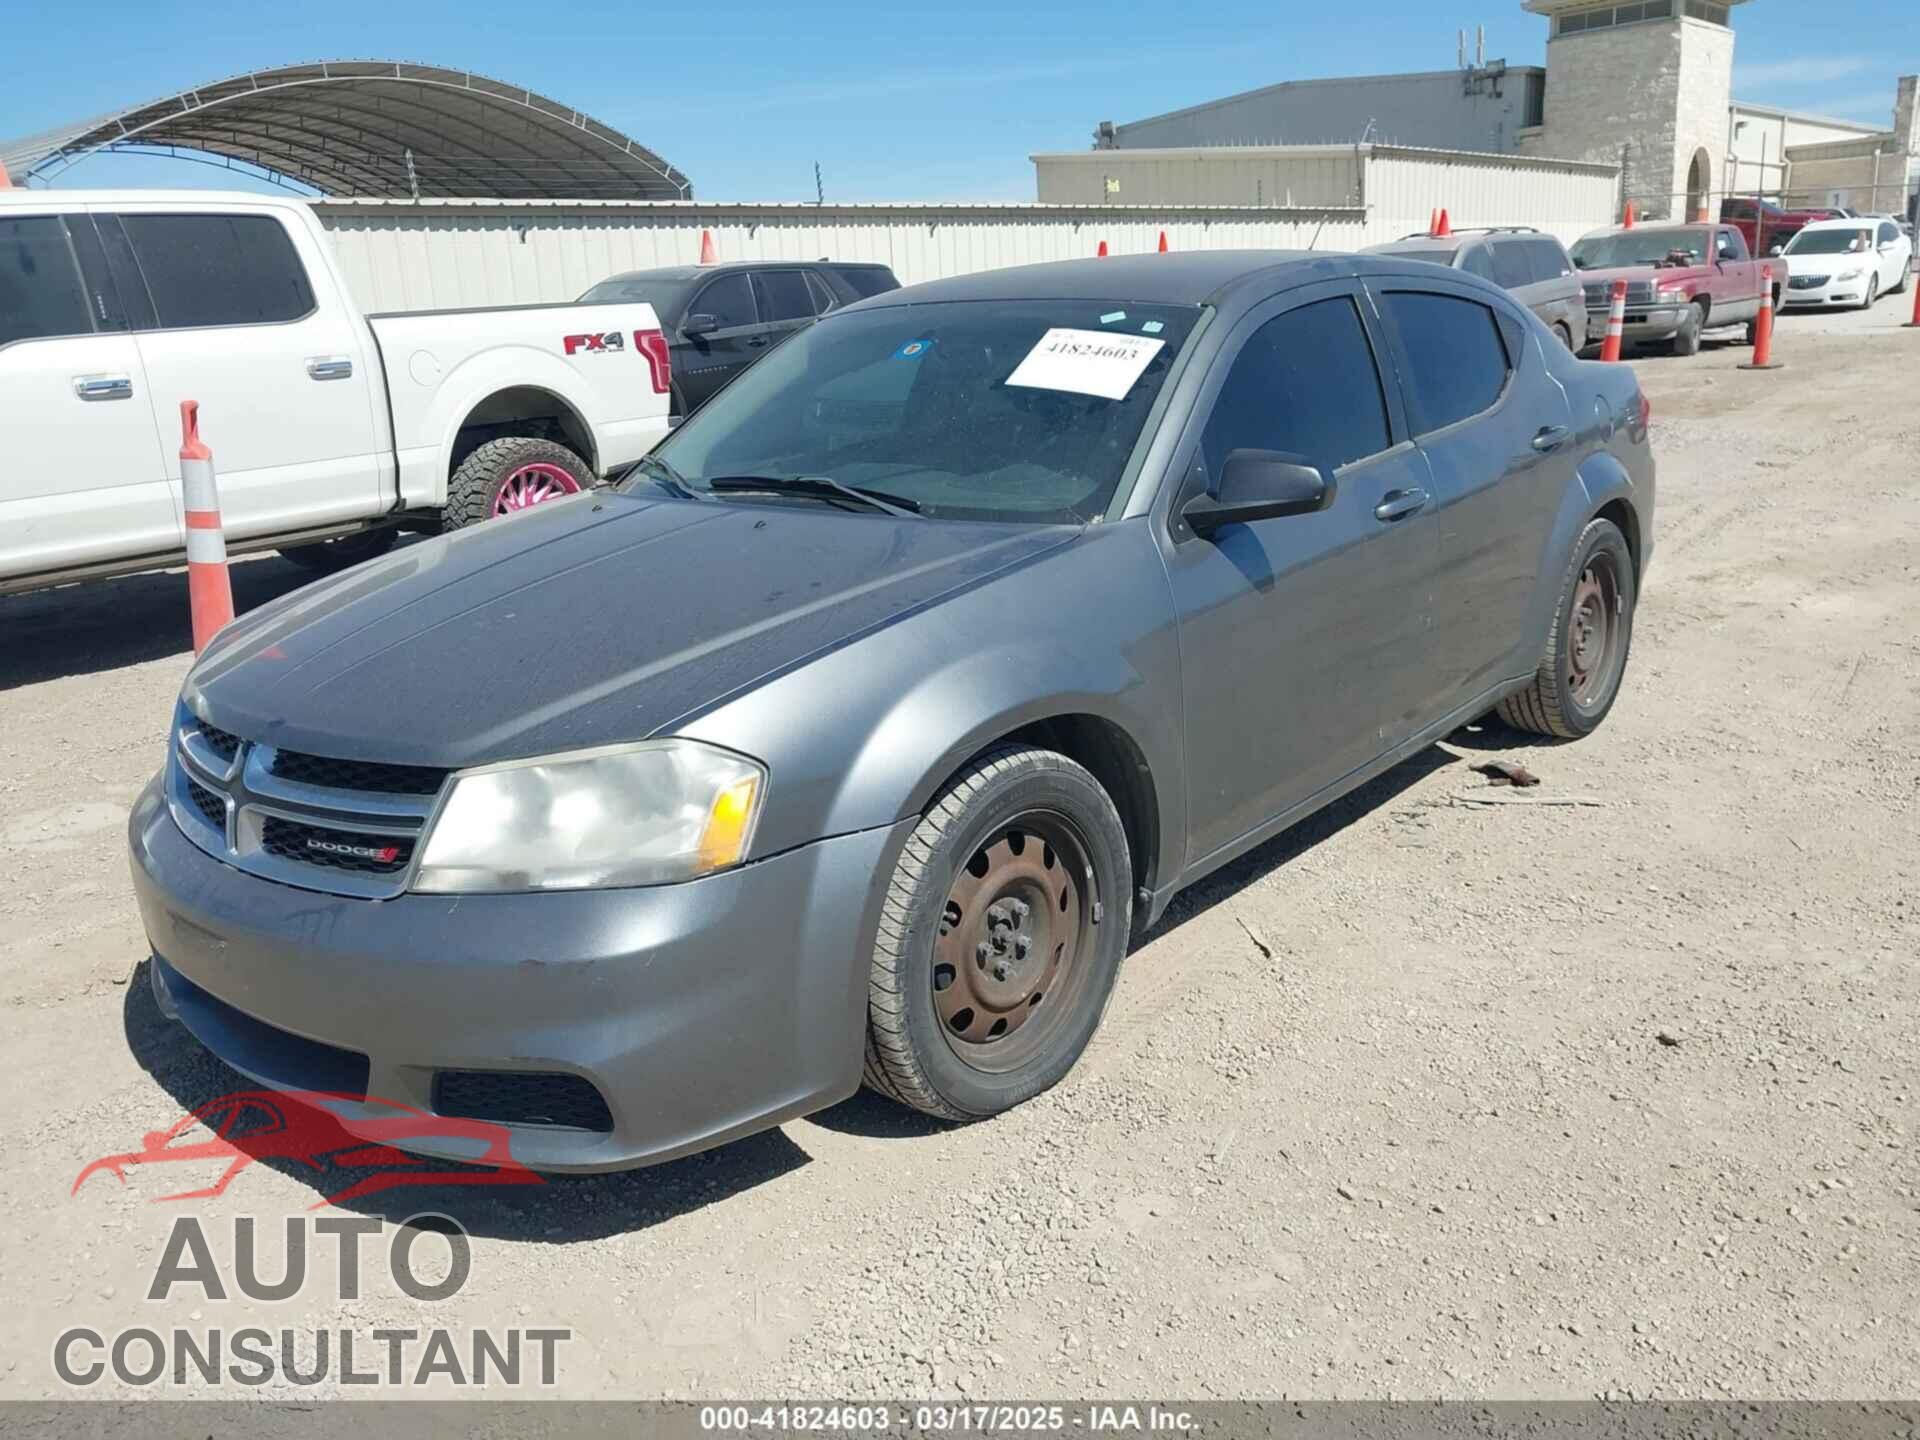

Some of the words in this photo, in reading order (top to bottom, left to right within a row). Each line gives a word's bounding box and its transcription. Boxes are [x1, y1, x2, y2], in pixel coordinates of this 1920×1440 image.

[563, 331, 624, 355] FX4
[1048, 342, 1139, 360] 41824603
[306, 838, 385, 858] DODGE
